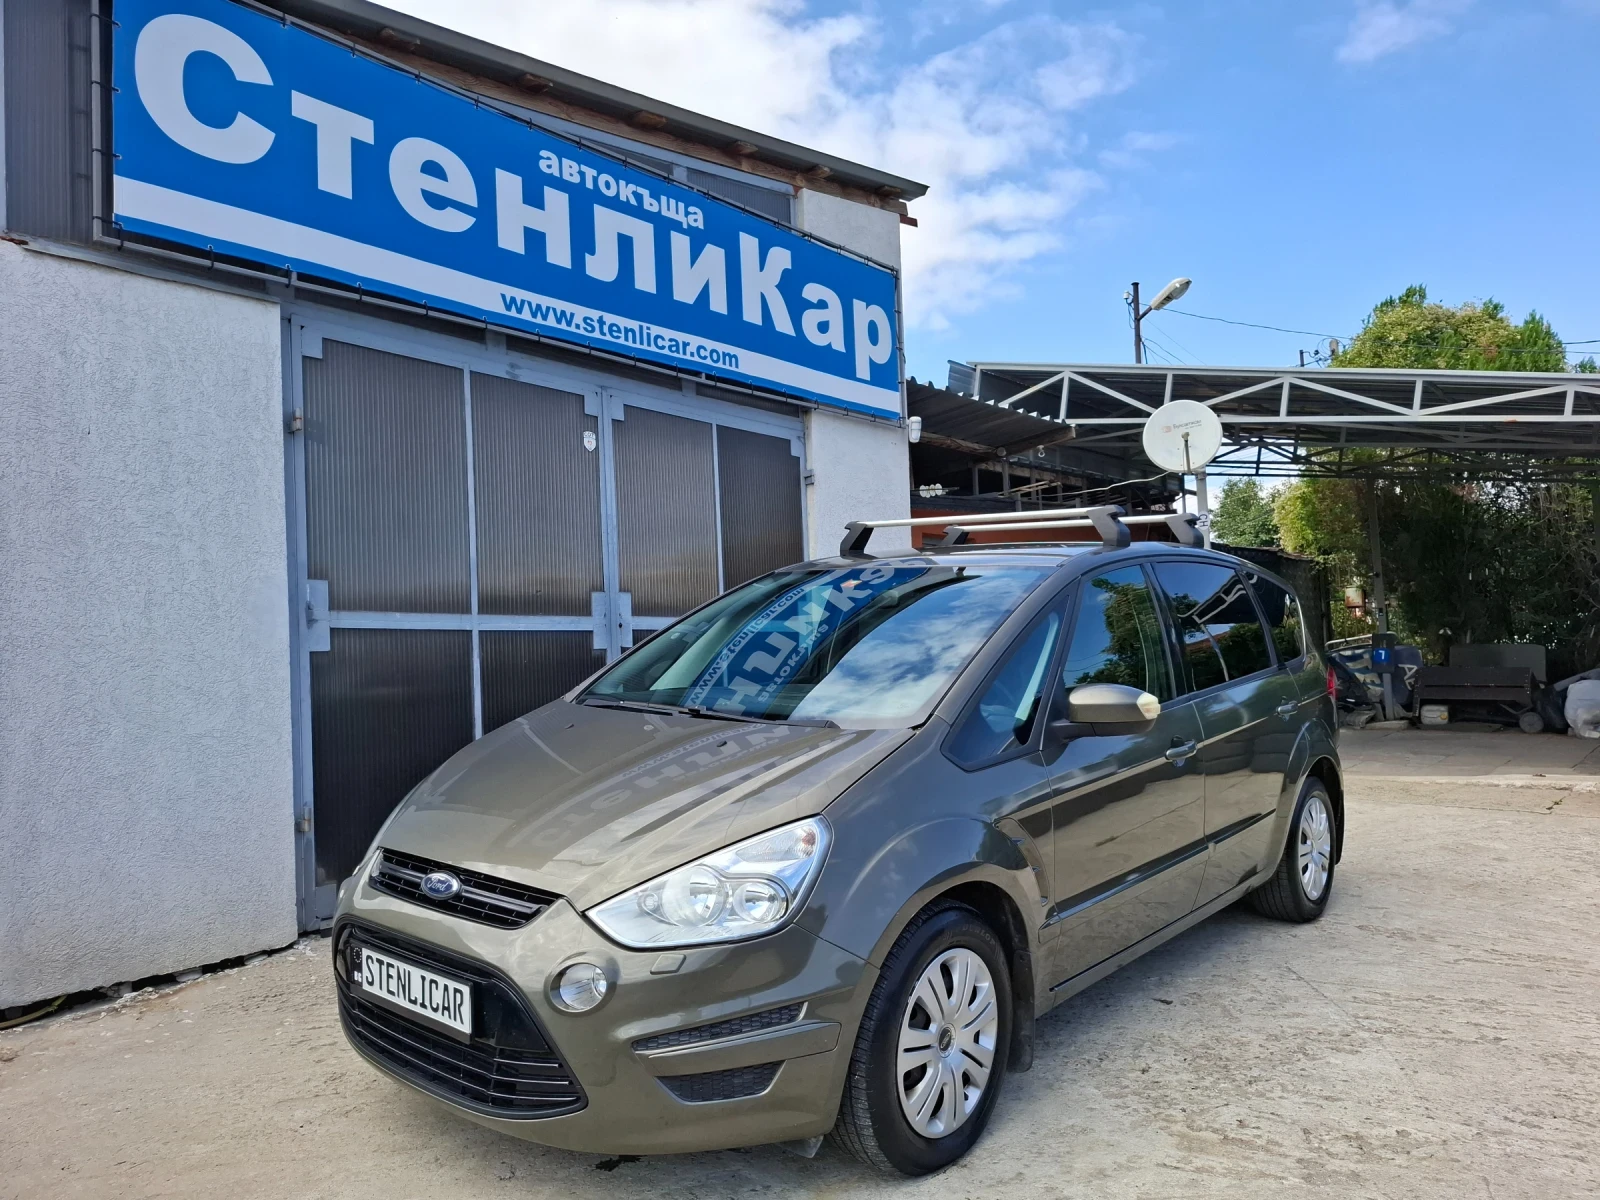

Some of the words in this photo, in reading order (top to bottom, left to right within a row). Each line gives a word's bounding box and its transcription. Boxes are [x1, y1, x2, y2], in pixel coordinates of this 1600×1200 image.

[134, 13, 892, 381] СтенлиКар
[538, 149, 704, 230] автокъща
[500, 292, 739, 369] www.stenlicar.com
[426, 875, 450, 892] Ford
[365, 954, 465, 1026] STENLICAR
